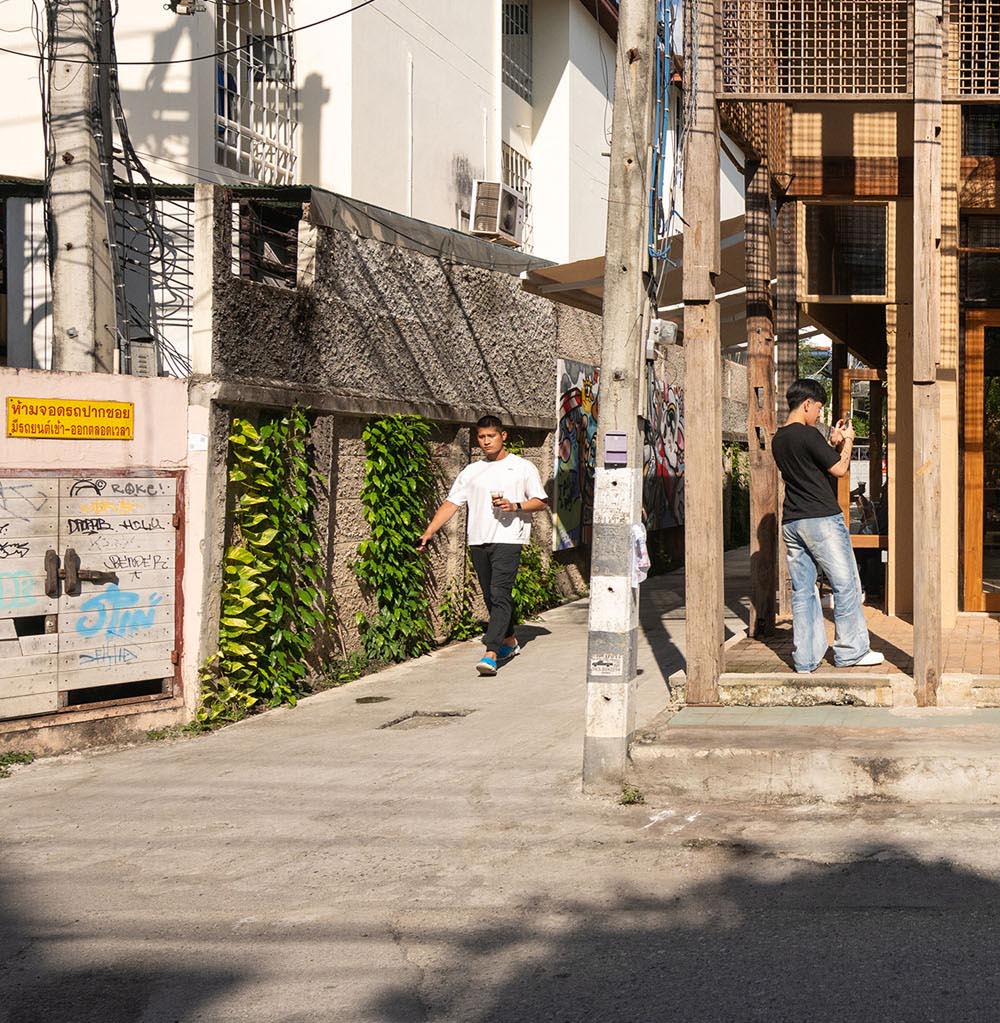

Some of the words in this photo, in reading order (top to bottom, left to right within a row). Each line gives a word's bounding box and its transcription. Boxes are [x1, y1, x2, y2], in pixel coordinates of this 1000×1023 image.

[11, 399, 130, 419] ห้ามจอดรถปากซอย
